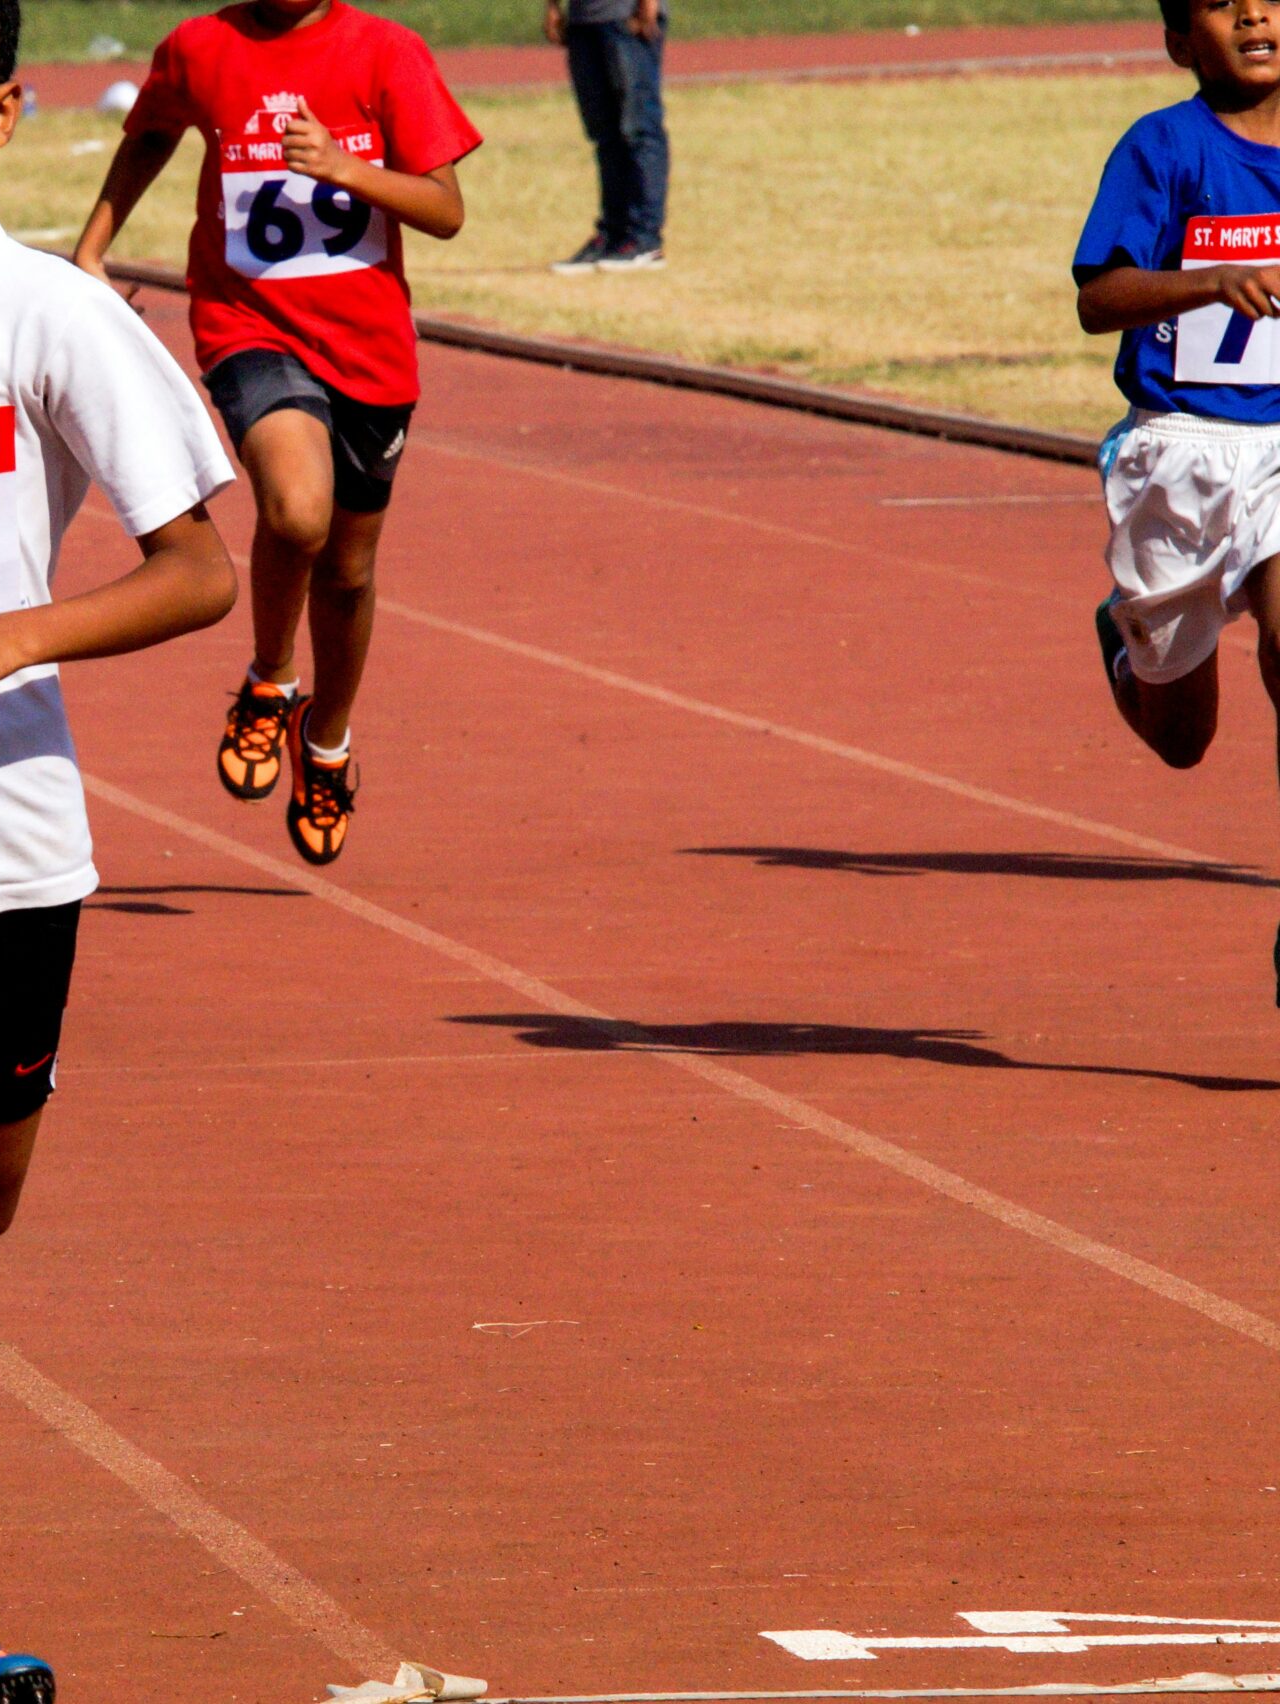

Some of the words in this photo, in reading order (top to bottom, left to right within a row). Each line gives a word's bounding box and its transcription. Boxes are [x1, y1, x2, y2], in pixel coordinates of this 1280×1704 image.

[248, 141, 283, 161] MARY
[246, 178, 372, 263] 69
[1193, 227, 1215, 247] ST.
[1219, 225, 1272, 249] MARY'S
